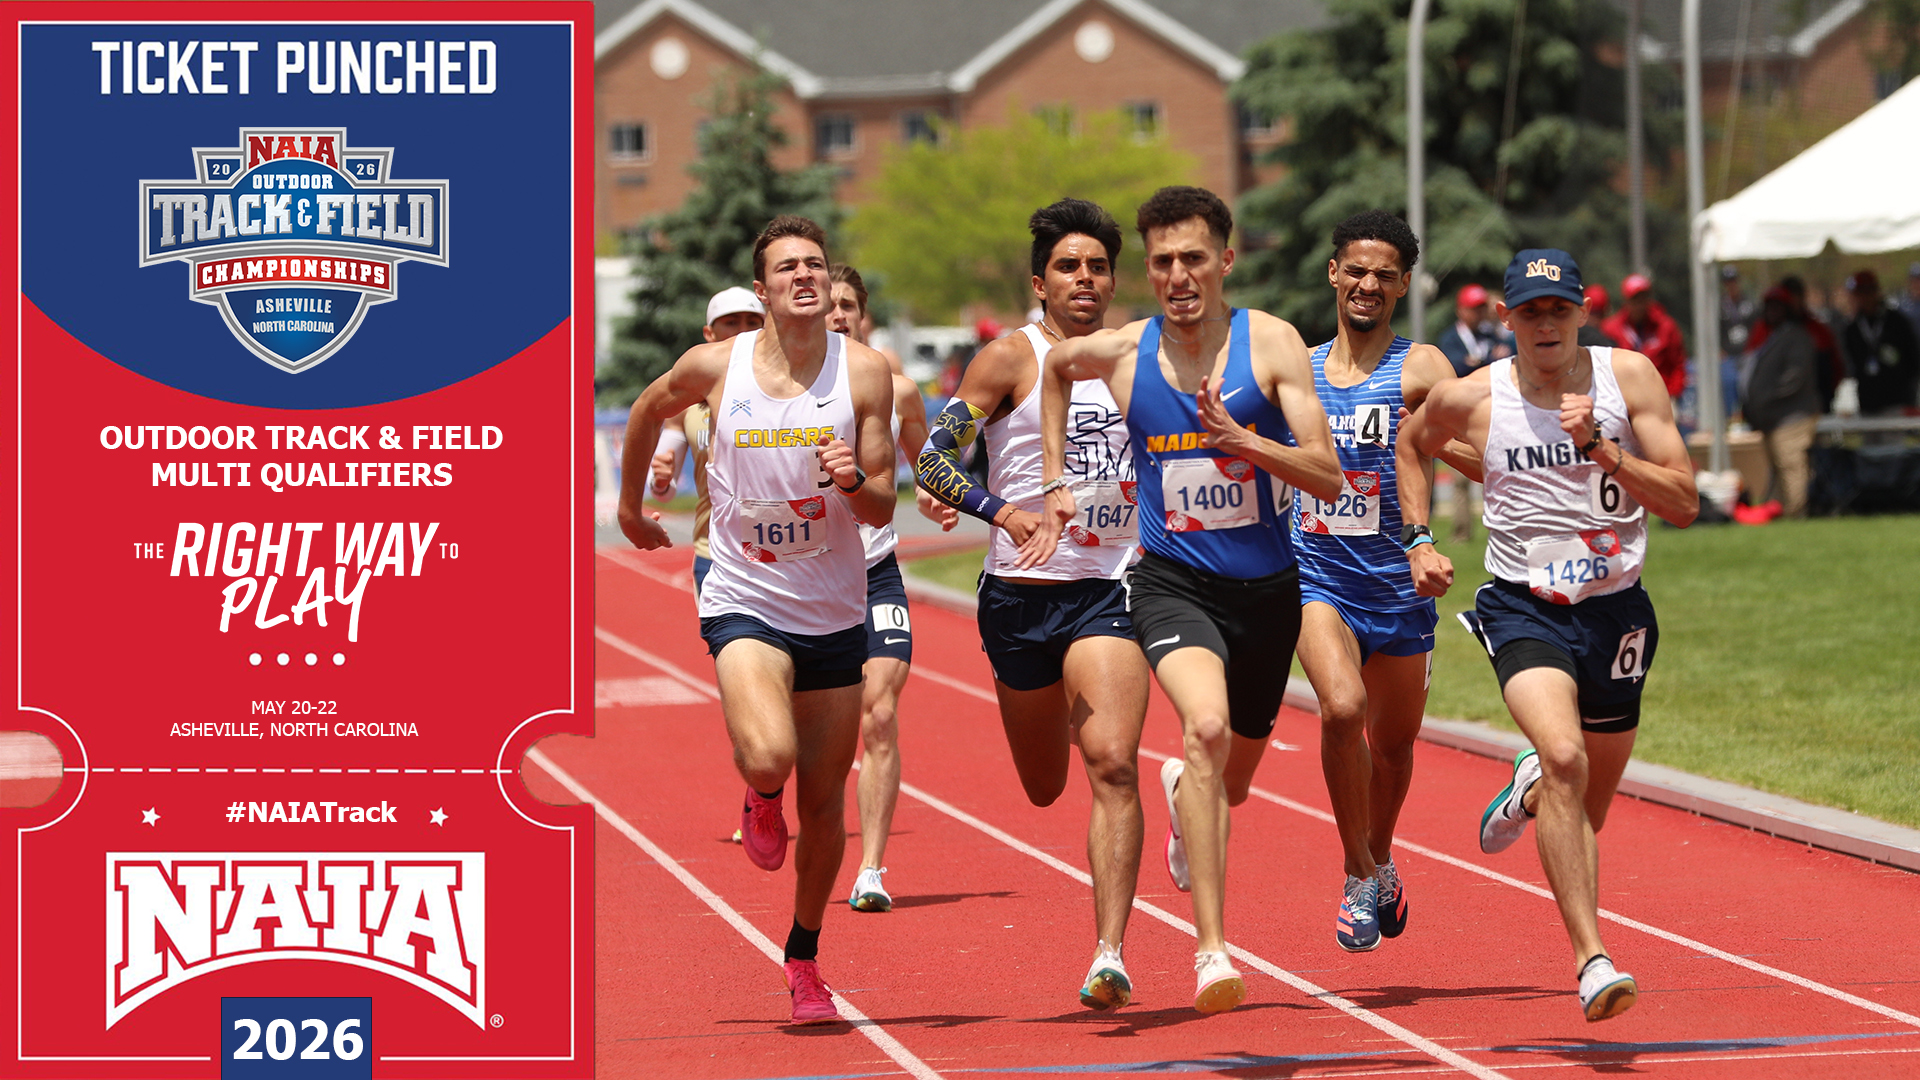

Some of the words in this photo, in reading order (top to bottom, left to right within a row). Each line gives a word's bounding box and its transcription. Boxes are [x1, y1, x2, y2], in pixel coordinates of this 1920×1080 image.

[1526, 258, 1561, 282] MU
[734, 426, 836, 448] COUGARS
[1362, 408, 1383, 443] 4
[1177, 482, 1243, 512] 1400
[1312, 493, 1367, 518] 1526
[1600, 471, 1620, 513] 6
[1084, 505, 1134, 528] 1647
[753, 520, 810, 545] 1611
[1544, 557, 1609, 586] 1426
[1619, 632, 1639, 676] 6
